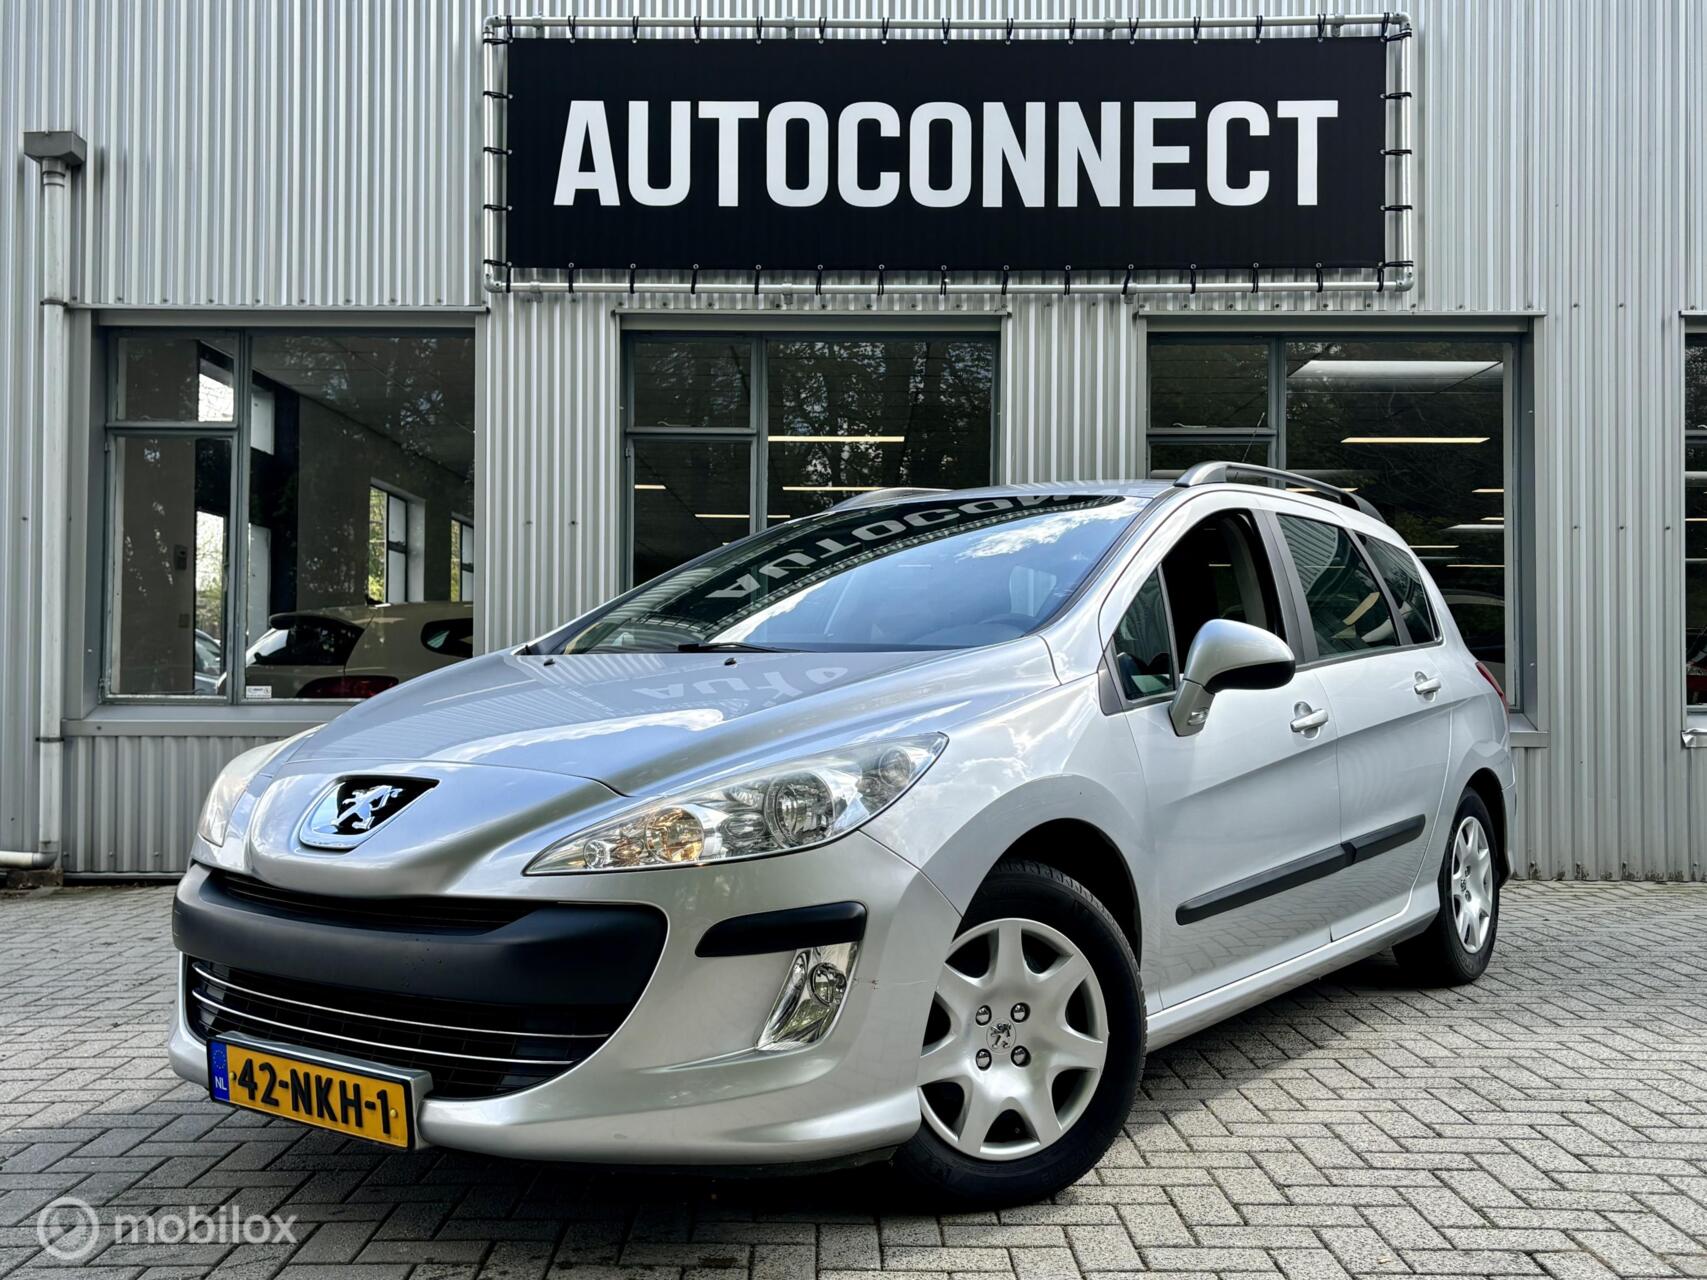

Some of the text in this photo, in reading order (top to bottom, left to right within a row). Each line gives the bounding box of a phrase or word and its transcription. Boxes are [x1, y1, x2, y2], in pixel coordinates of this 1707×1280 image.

[553, 100, 1338, 207] AUTOCONNECT
[214, 1076, 227, 1091] NL
[237, 1058, 391, 1135] 42-NKH-1
